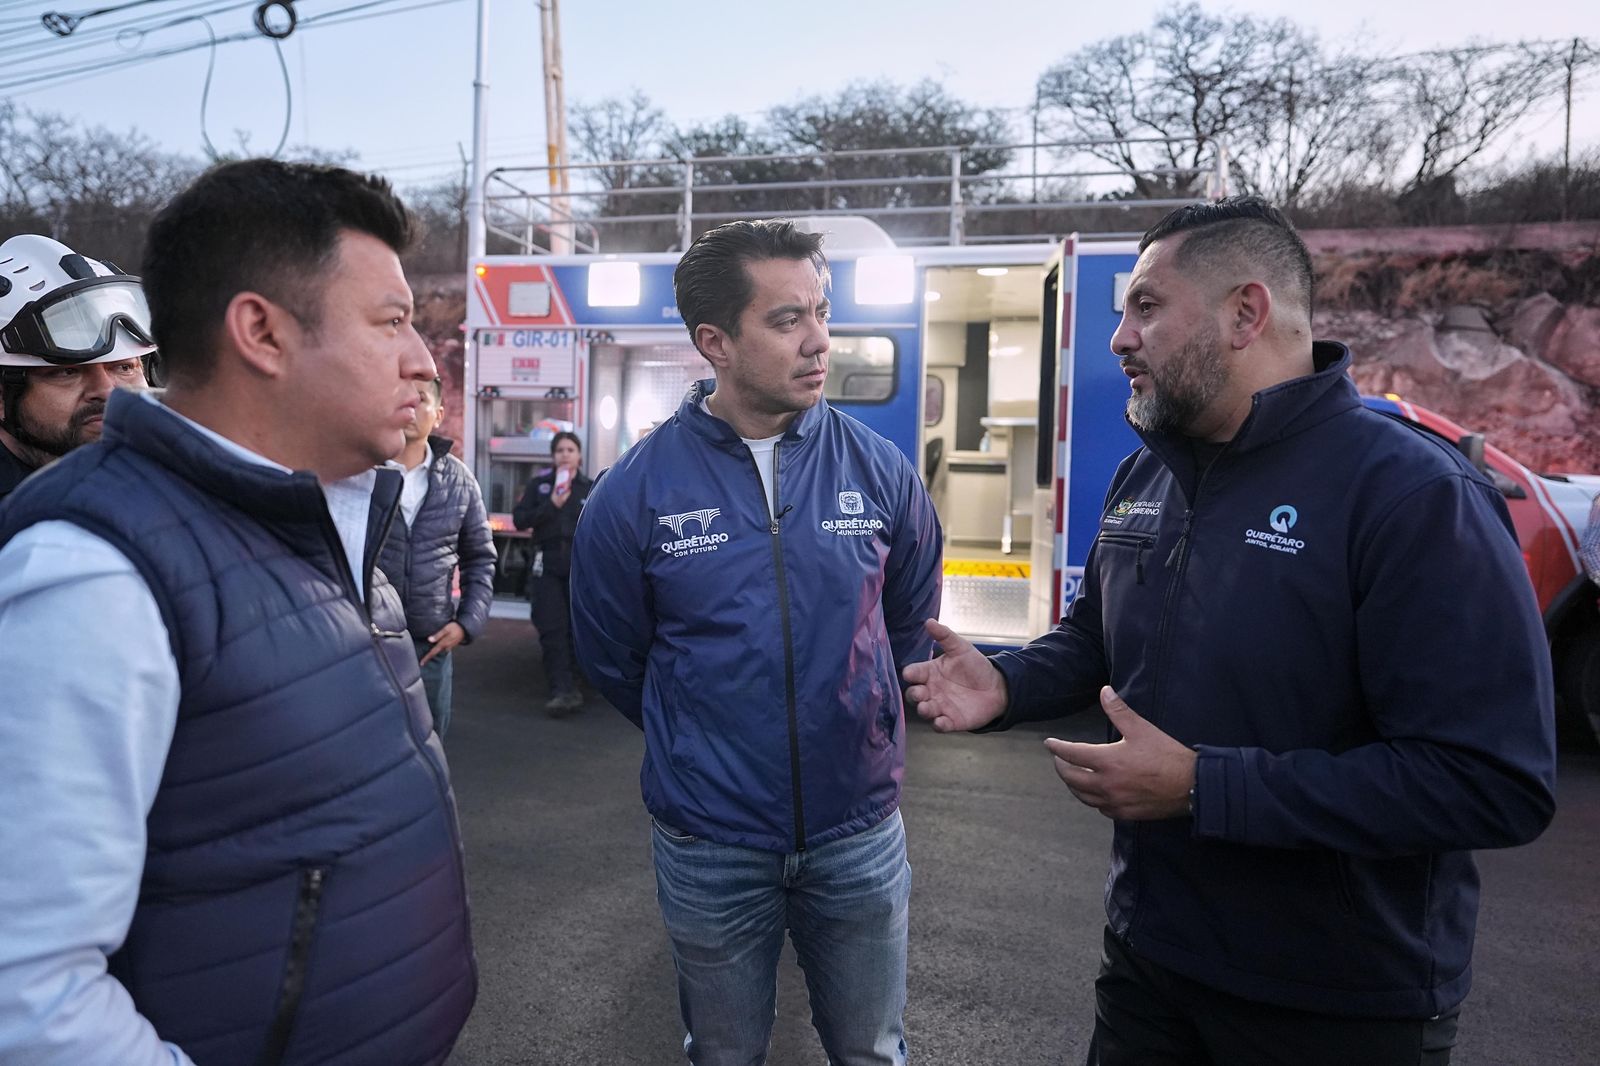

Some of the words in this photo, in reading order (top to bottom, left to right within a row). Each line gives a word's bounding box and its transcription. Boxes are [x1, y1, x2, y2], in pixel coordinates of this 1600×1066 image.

[512, 331, 568, 347] GIR-01
[821, 518, 883, 533] QUERÉTARO
[661, 533, 729, 554] QUERÉTARO
[1245, 529, 1305, 549] QUERÉTARO
[674, 549, 689, 558] CON
[690, 545, 718, 555] FUTURO
[1269, 544, 1298, 555] ADELANTE
